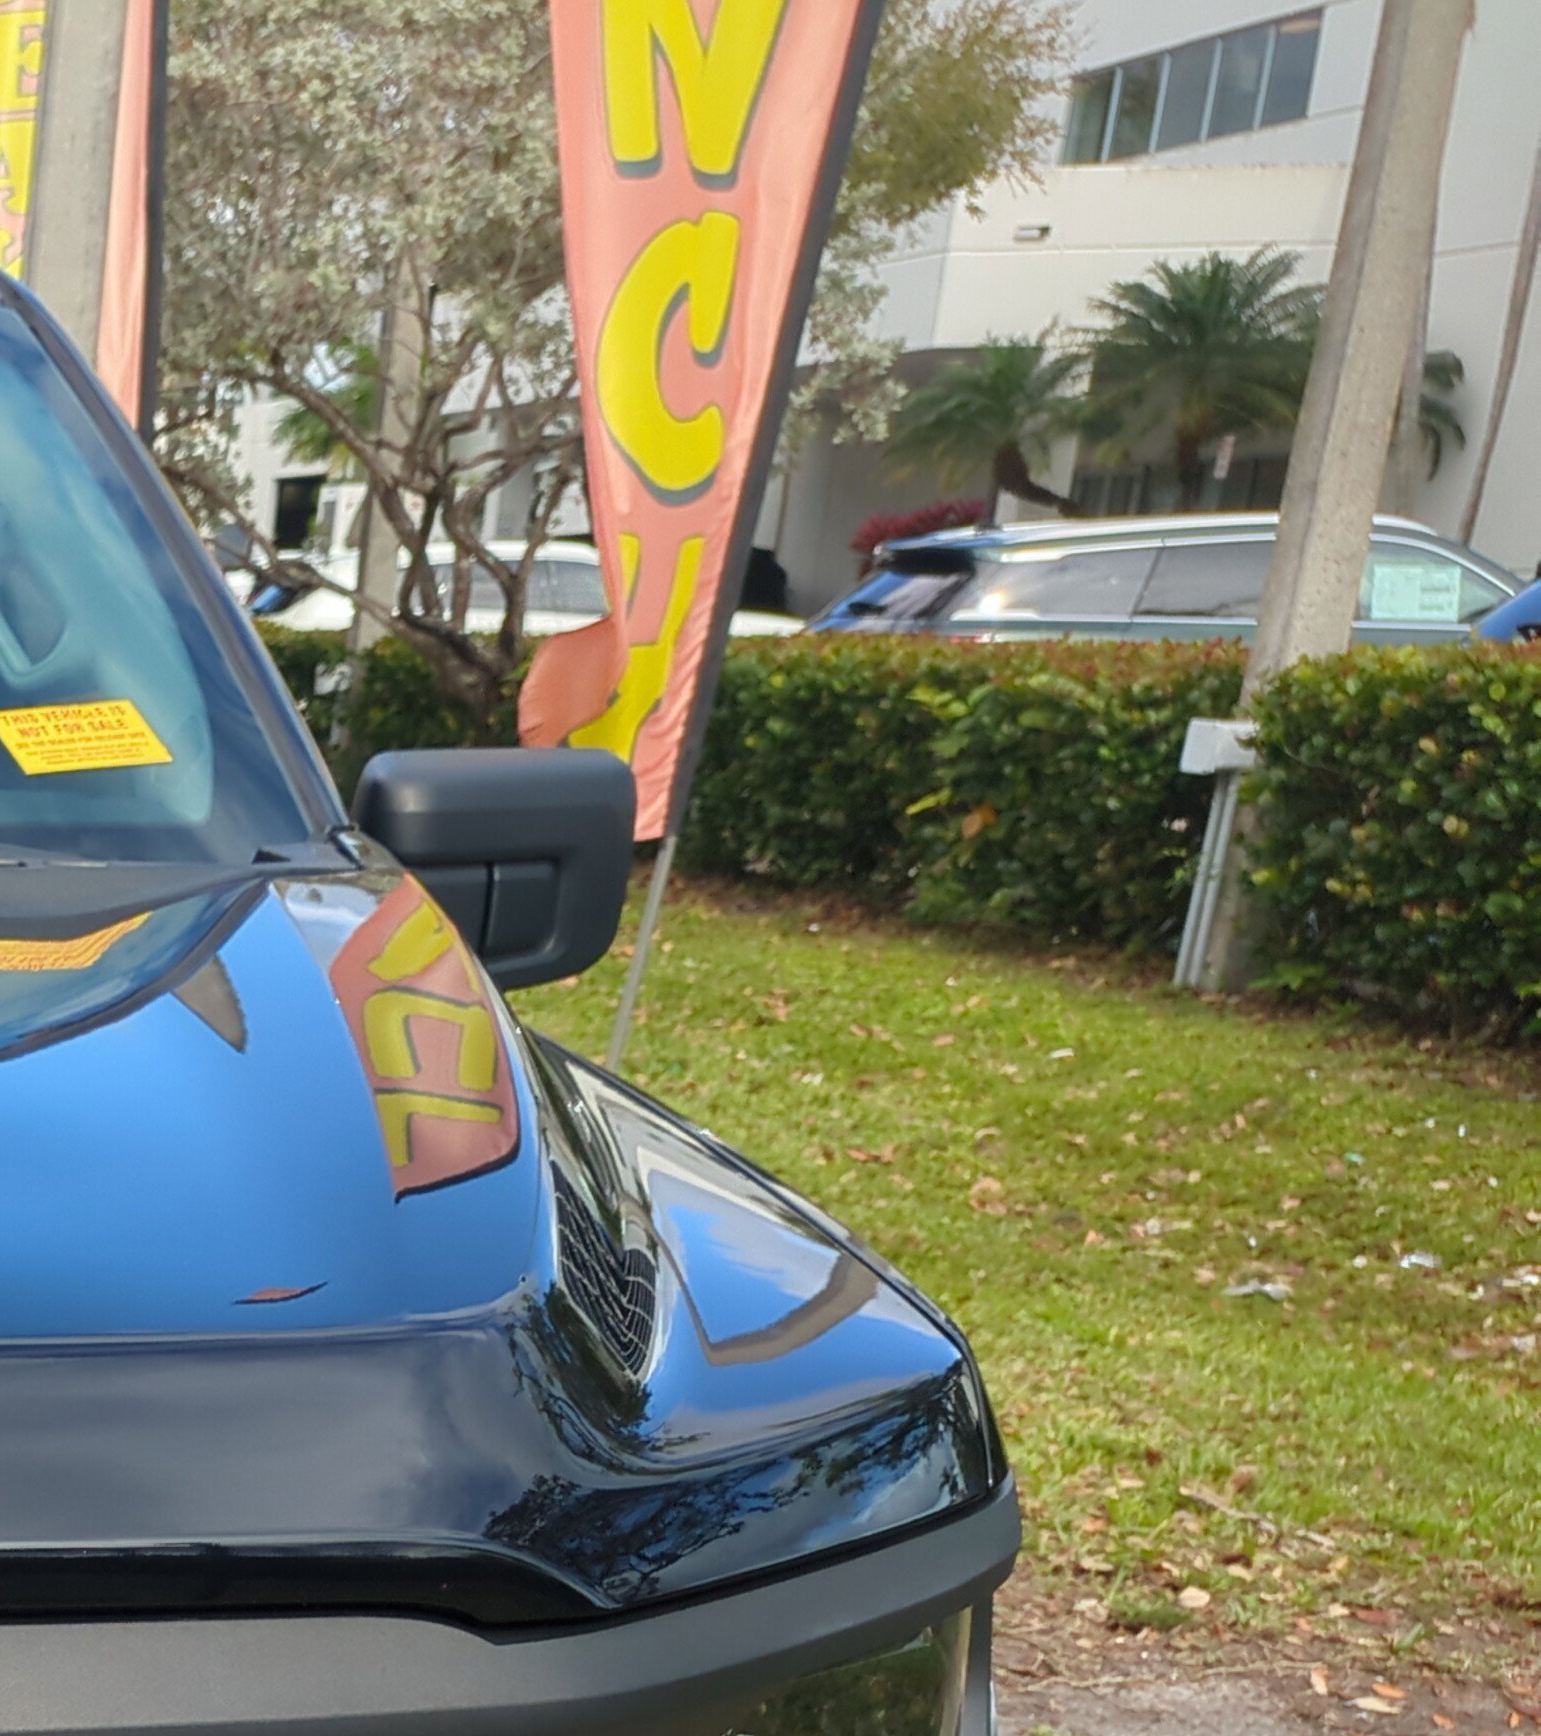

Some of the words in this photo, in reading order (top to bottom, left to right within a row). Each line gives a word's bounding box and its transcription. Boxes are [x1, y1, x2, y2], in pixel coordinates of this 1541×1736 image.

[39, 706, 108, 723] VEHICLE
[109, 704, 126, 717] IS
[18, 724, 49, 738] NOT
[53, 721, 86, 735] FOR
[87, 718, 129, 733] SALE
